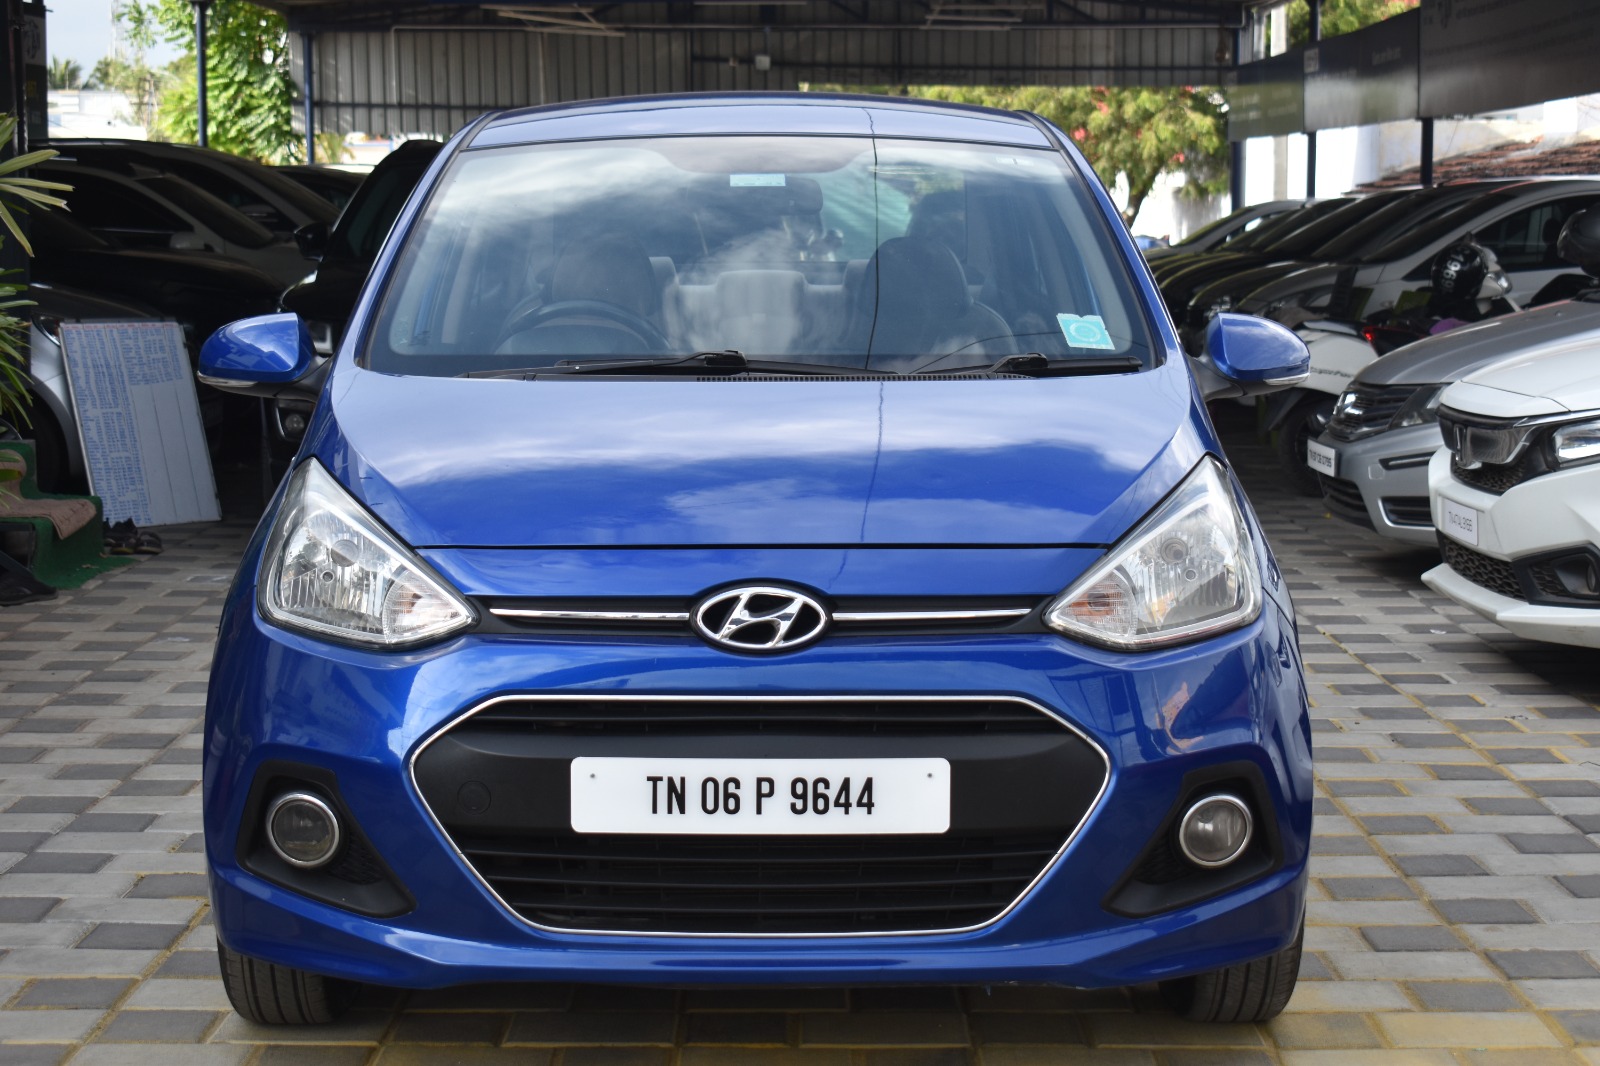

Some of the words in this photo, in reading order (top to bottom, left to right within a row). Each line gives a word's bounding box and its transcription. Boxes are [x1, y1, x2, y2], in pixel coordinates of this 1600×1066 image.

[646, 776, 686, 815] TN
[700, 776, 741, 815] 06
[755, 776, 775, 816] P
[790, 776, 875, 816] 9644
